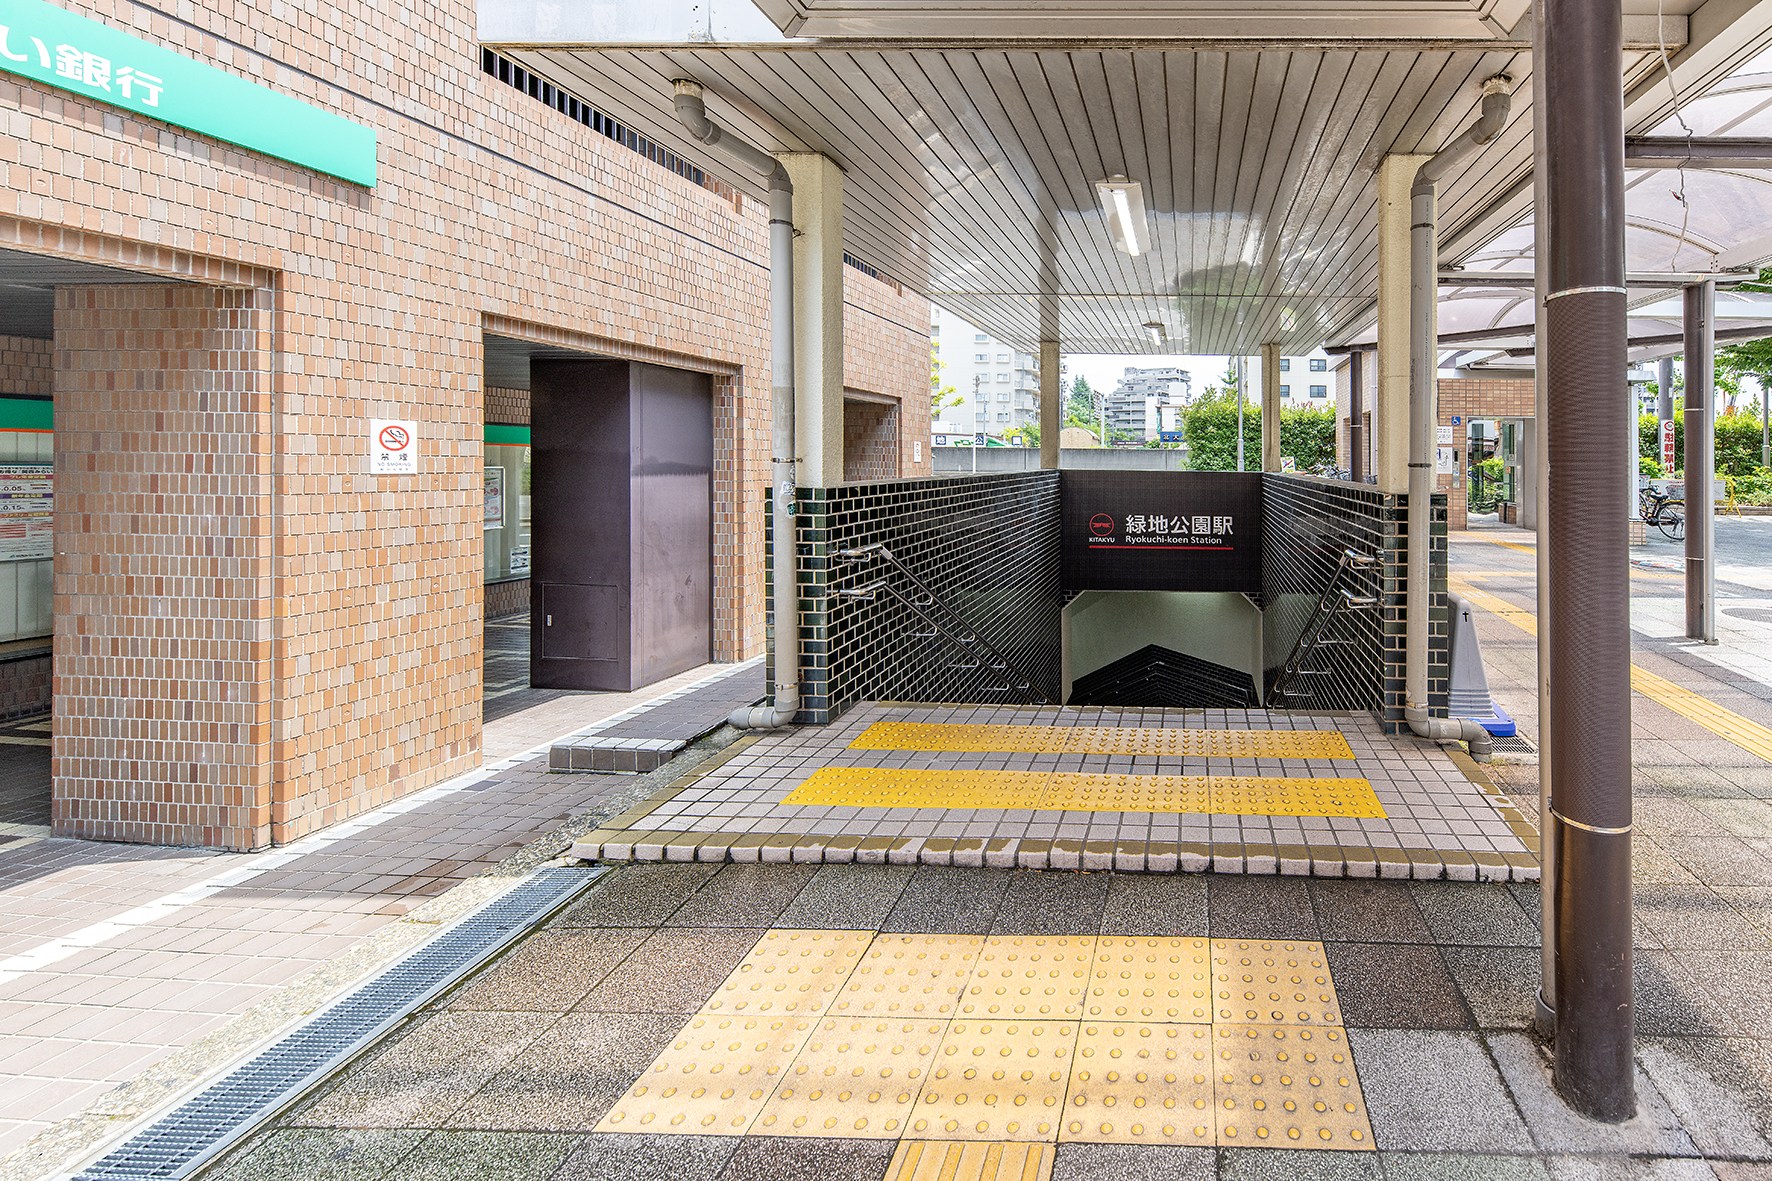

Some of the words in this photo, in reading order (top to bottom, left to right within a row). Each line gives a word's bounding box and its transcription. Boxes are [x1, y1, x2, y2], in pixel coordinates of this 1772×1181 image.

[381, 453, 408, 461] 禁煙
[1125, 514, 1234, 535] 緑地公園駅
[1125, 536, 1189, 545] Ryokuchi-koen
[1190, 536, 1222, 544] Station
